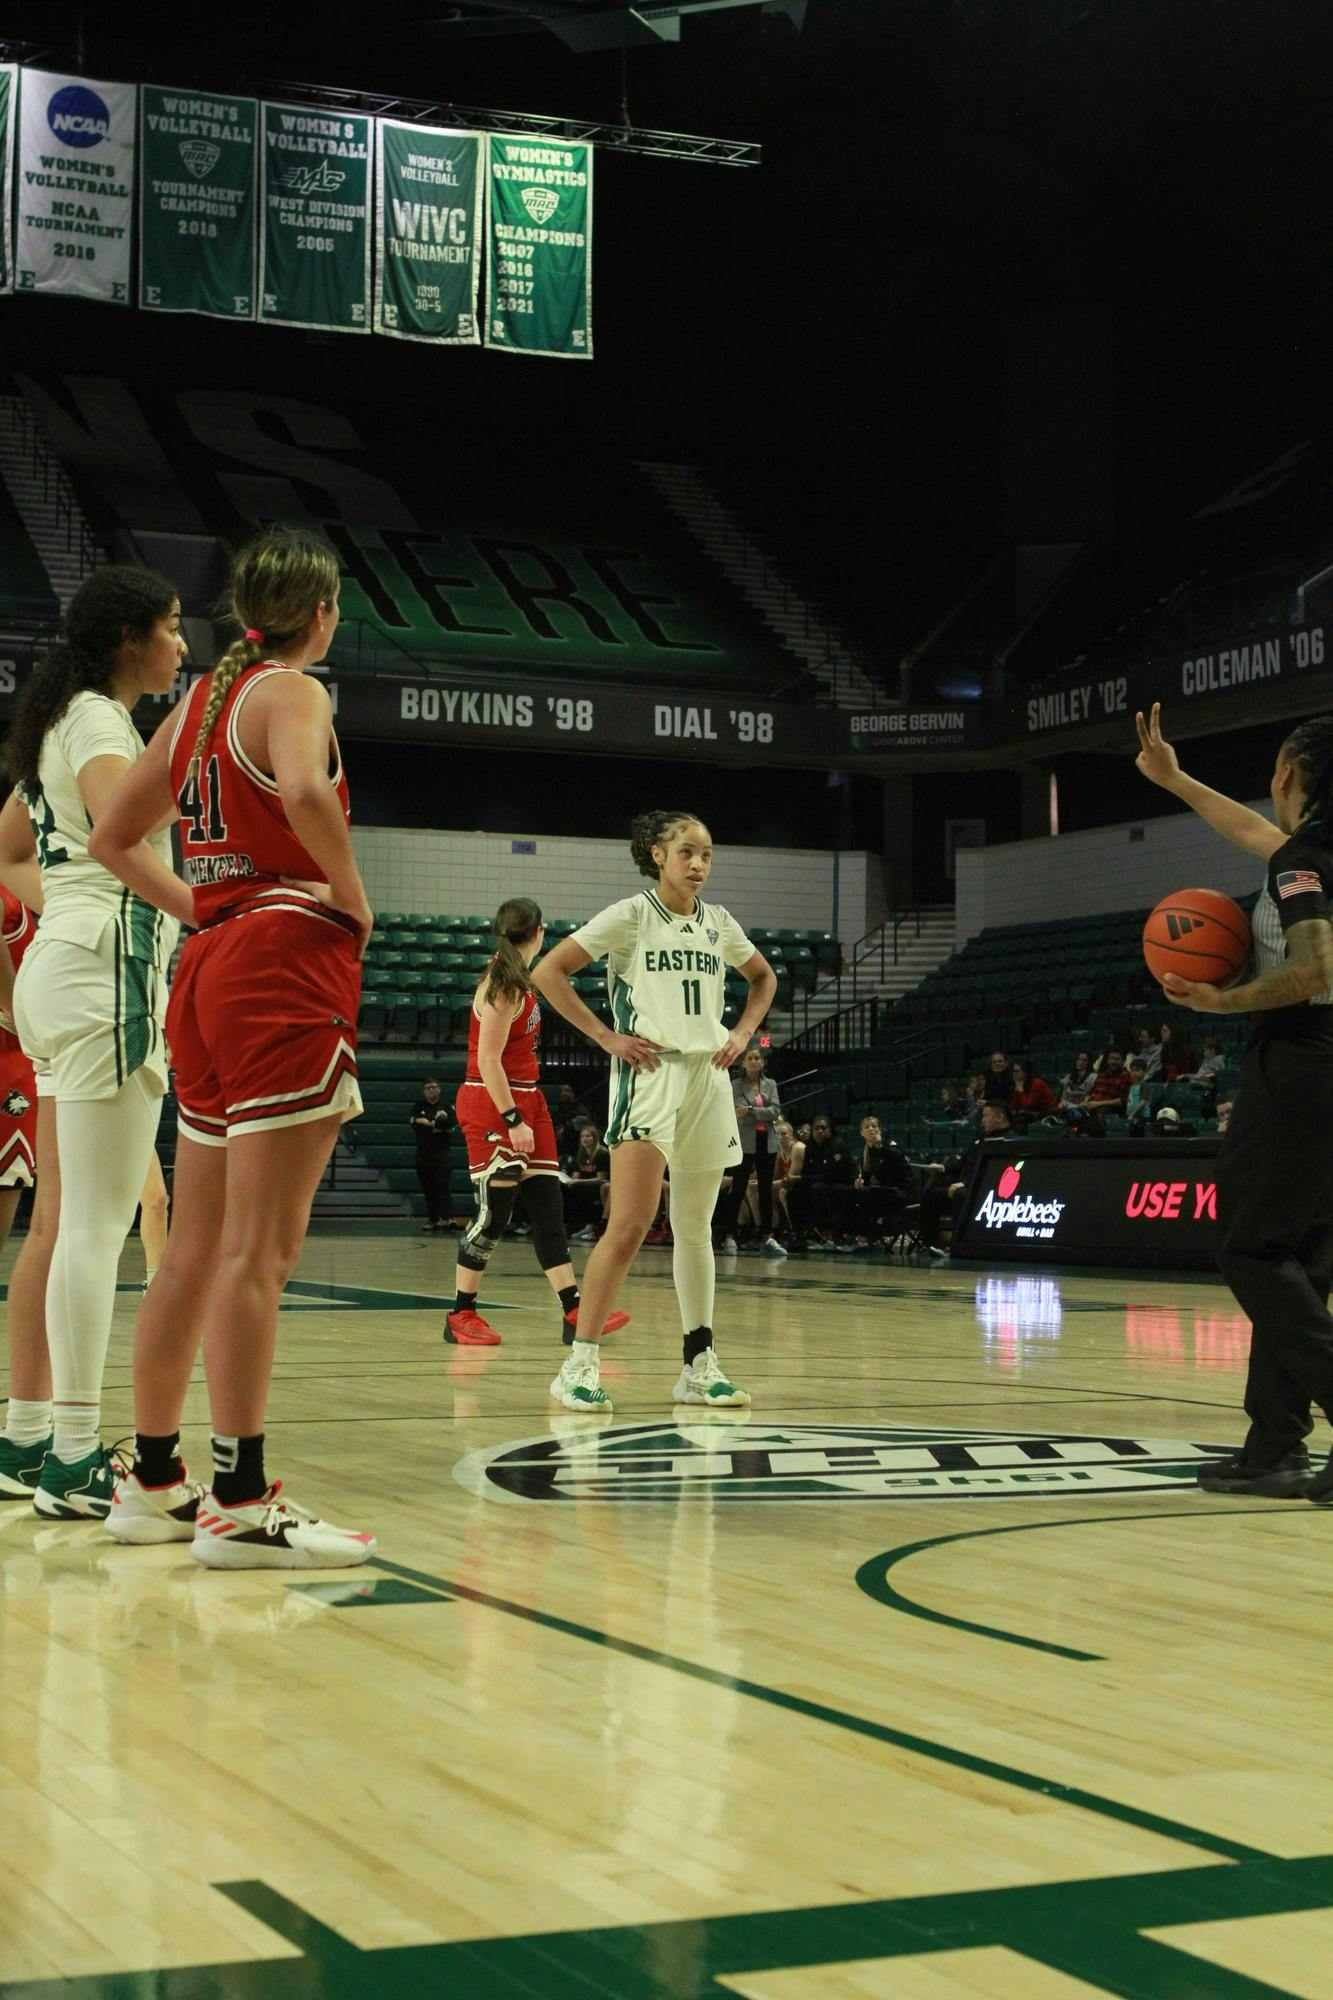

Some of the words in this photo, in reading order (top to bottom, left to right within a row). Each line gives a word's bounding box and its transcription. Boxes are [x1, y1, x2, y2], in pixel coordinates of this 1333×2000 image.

[162, 97, 238, 121] WOMEN'S
[53, 113, 107, 136] NCAA
[148, 114, 251, 143] VOLLEYBALL
[281, 114, 354, 138] WOMENS
[267, 132, 367, 159] VOLLEYBALL
[505, 146, 574, 167] WOMEN'S
[40, 155, 115, 178] WOMEN'S
[408, 153, 453, 172] WOMEN'S
[25, 172, 128, 197] VOLLEYBALL
[400, 166, 460, 187] VOLLEYBALL
[492, 165, 586, 187] GYMNASTICS
[152, 181, 245, 203] TOURNAMENT
[51, 200, 100, 221] NCAA
[160, 197, 236, 218] CHAMPIONS
[268, 195, 305, 213] WEST
[309, 200, 365, 219] DIVISION
[25, 215, 125, 239] TOURNAMENT
[279, 212, 353, 233] CHAMPIONS
[392, 198, 466, 244] WIVC
[494, 223, 584, 247] CHAMPIONS
[389, 237, 471, 264] TOURNAMENT
[498, 242, 535, 259] 2007
[19, 270, 36, 289] E
[111, 282, 125, 300] E
[498, 279, 534, 296] 2017
[146, 286, 161, 305] E
[233, 296, 249, 315] E
[264, 293, 277, 312] E
[497, 297, 534, 314] 2021
[351, 304, 365, 321] E
[384, 303, 398, 328] E
[458, 313, 472, 336] E
[572, 329, 585, 347] E
[1182, 638, 1281, 696] COLEMAN
[1290, 627, 1325, 668] '06
[401, 687, 533, 727] BOYKINS
[547, 697, 594, 731] '98
[1028, 685, 1092, 731] SMILEY
[1099, 677, 1128, 713] '02
[654, 705, 717, 740] DIAL
[729, 710, 773, 743] '98
[851, 715, 907, 733] GEORGE
[909, 712, 964, 730] GERVIN
[178, 754, 227, 844] 41
[645, 950, 720, 976] EASTERN
[682, 979, 702, 1015] 11
[975, 1189, 1065, 1228] Applebee's
[1125, 1182, 1187, 1218] USE
[1016, 1227, 1035, 1237] GRILL
[1040, 1228, 1055, 1238] BAR
